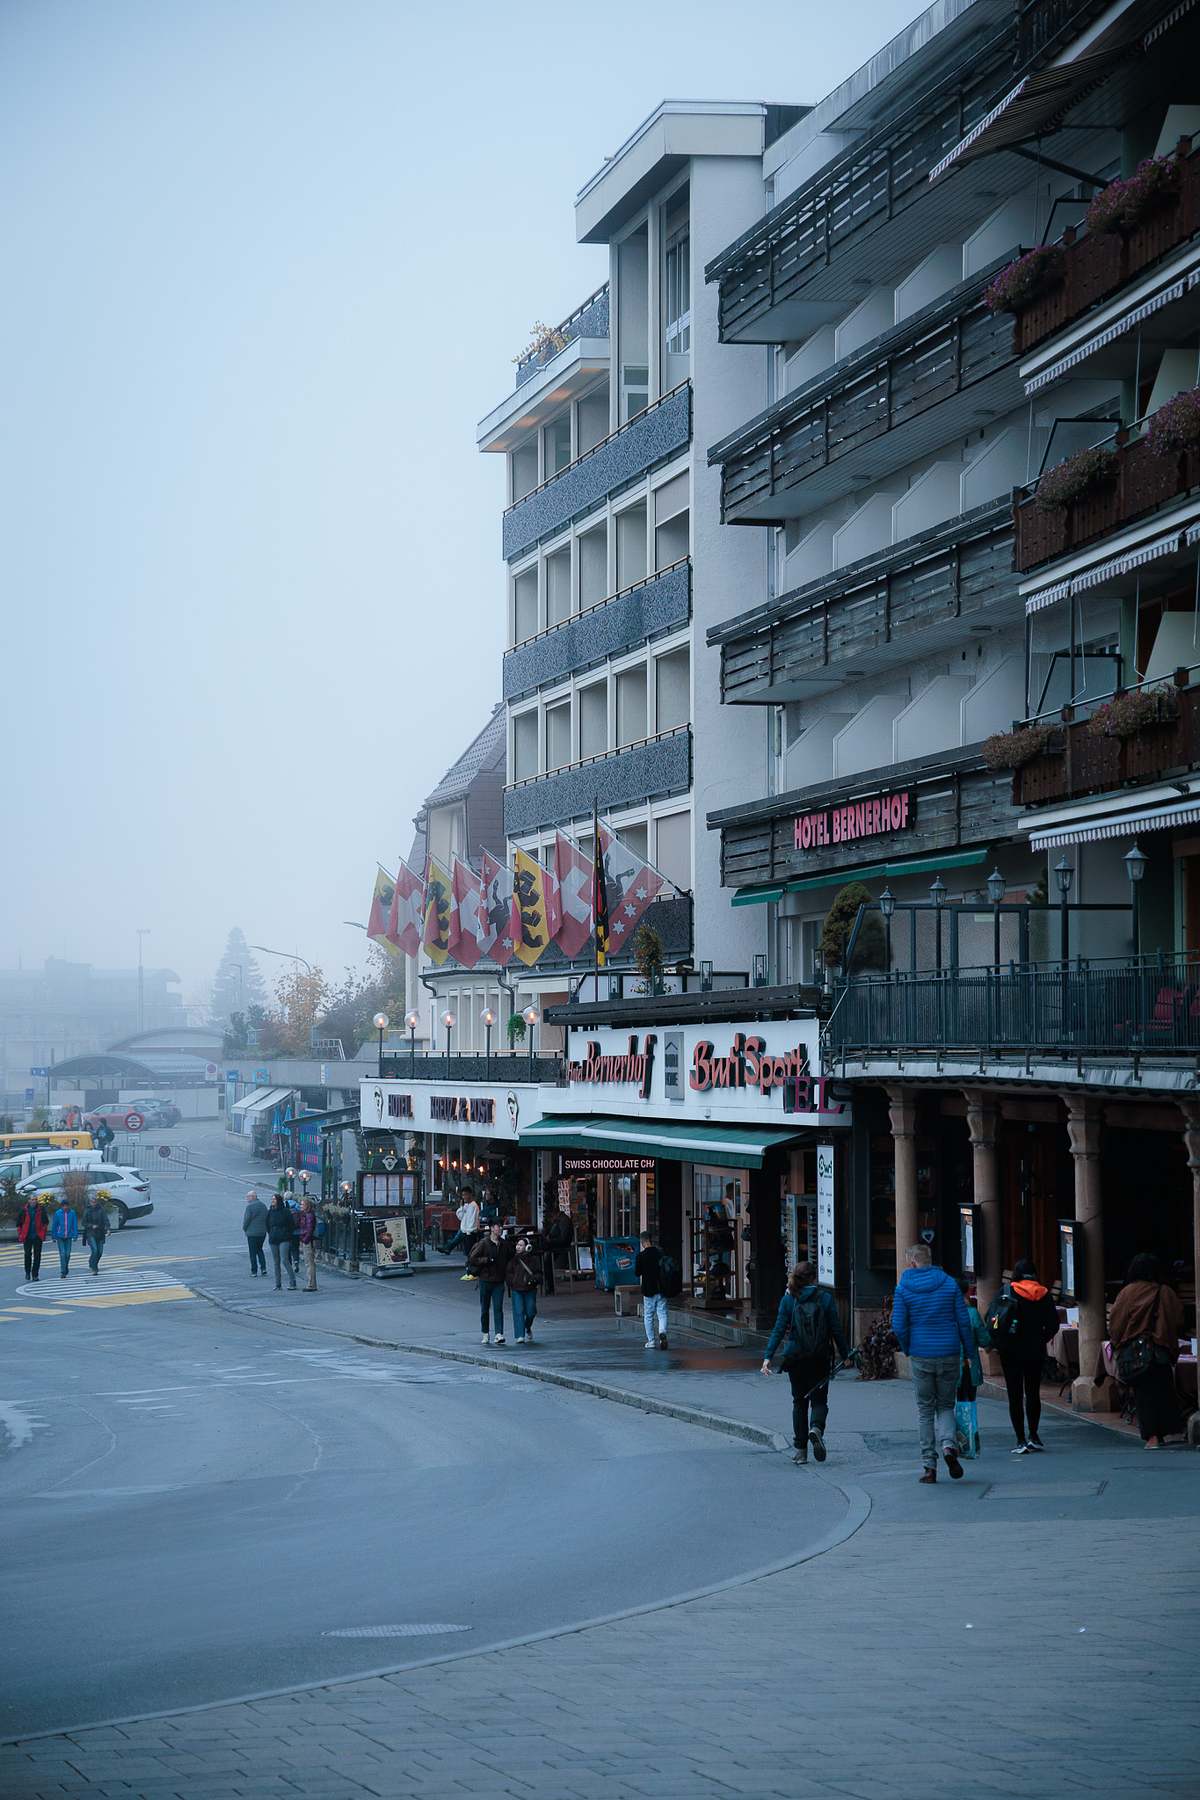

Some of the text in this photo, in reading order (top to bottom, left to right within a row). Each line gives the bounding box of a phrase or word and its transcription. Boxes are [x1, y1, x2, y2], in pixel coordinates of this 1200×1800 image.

[794, 792, 910, 850] HOTEL BERNERHOF
[585, 1034, 656, 1099] Bernerhof
[744, 1036, 806, 1095] Sport
[388, 1094, 413, 1117] HOTEL
[430, 1096, 458, 1120] KREUZ
[470, 1098, 495, 1123] POST
[564, 1159, 591, 1169] SWISS
[592, 1159, 640, 1169] CHOCOLATE
